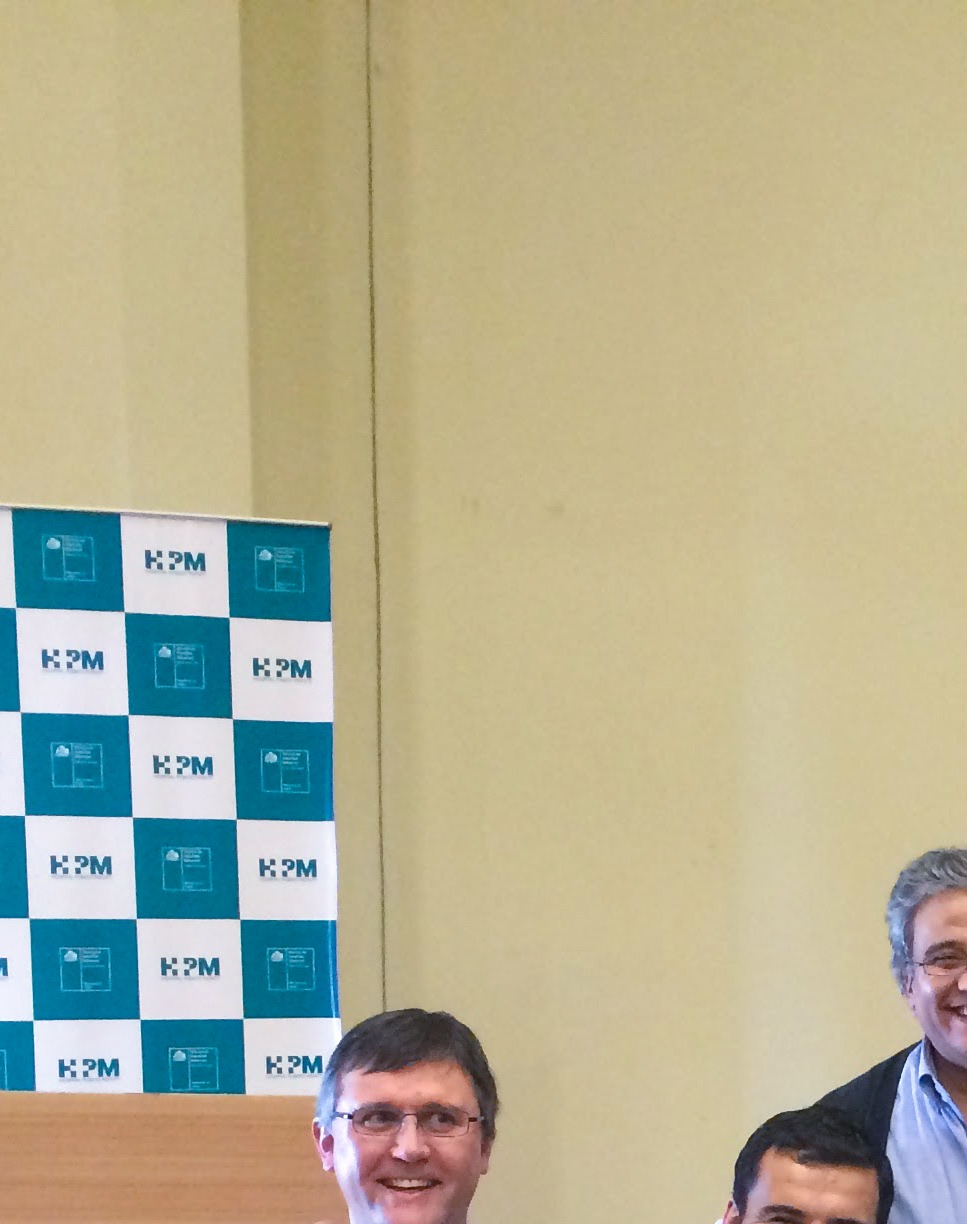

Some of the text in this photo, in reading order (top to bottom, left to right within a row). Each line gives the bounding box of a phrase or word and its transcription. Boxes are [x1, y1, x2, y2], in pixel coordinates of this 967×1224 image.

[145, 550, 206, 572] HPM
[42, 649, 104, 670] HPM
[253, 658, 312, 678] HPM
[153, 755, 213, 776] HPM
[51, 855, 112, 876] HPM
[259, 859, 317, 878] HPM
[161, 957, 220, 976] HPM
[59, 1058, 120, 1078] HPM
[266, 1056, 323, 1075] HPM
